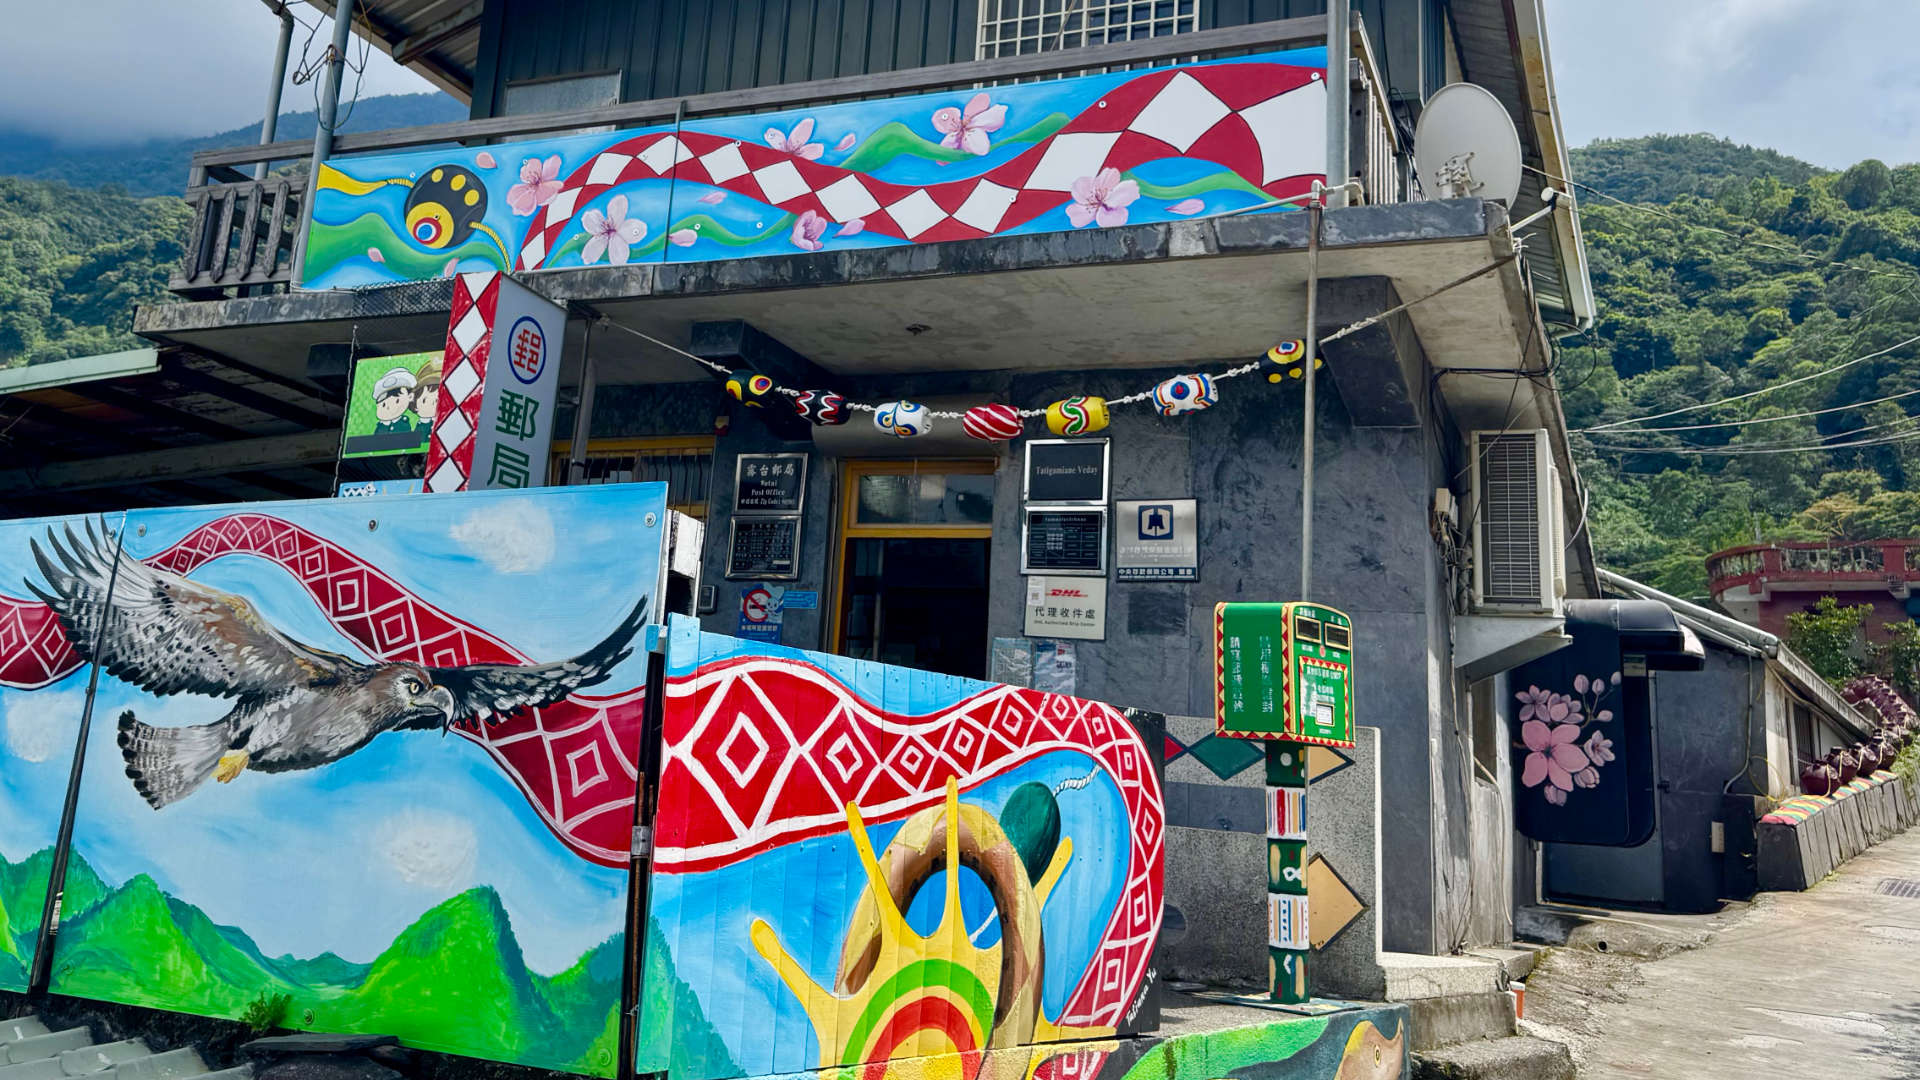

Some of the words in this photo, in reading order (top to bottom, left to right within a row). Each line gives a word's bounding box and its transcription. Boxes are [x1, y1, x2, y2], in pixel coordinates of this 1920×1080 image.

[487, 388, 540, 489] 郵局
[751, 489, 764, 497] Post
[1050, 588, 1081, 598] DHL
[1035, 606, 1096, 620] 代理收件處
